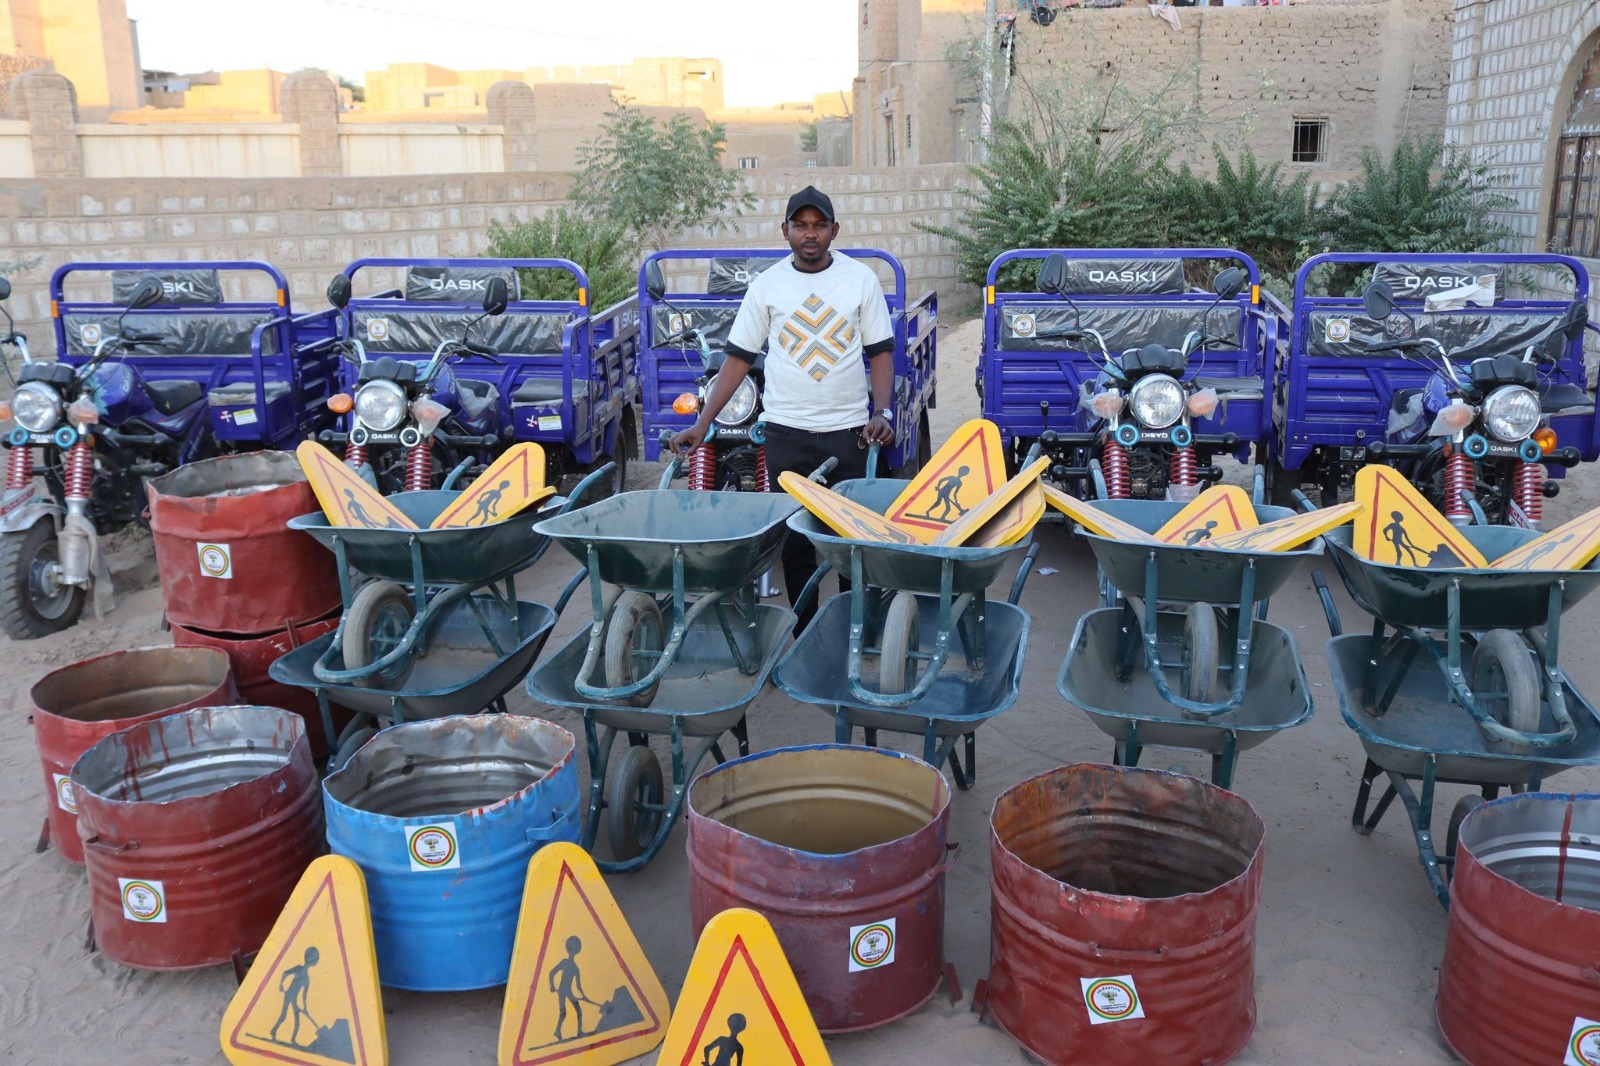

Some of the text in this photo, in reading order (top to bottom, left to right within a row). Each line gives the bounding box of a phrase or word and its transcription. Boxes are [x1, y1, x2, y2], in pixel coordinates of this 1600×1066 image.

[1089, 270, 1156, 283] QASKI
[1405, 275, 1477, 289] QASKI
[430, 278, 490, 291] QASK
[1490, 445, 1517, 453] QASKI
